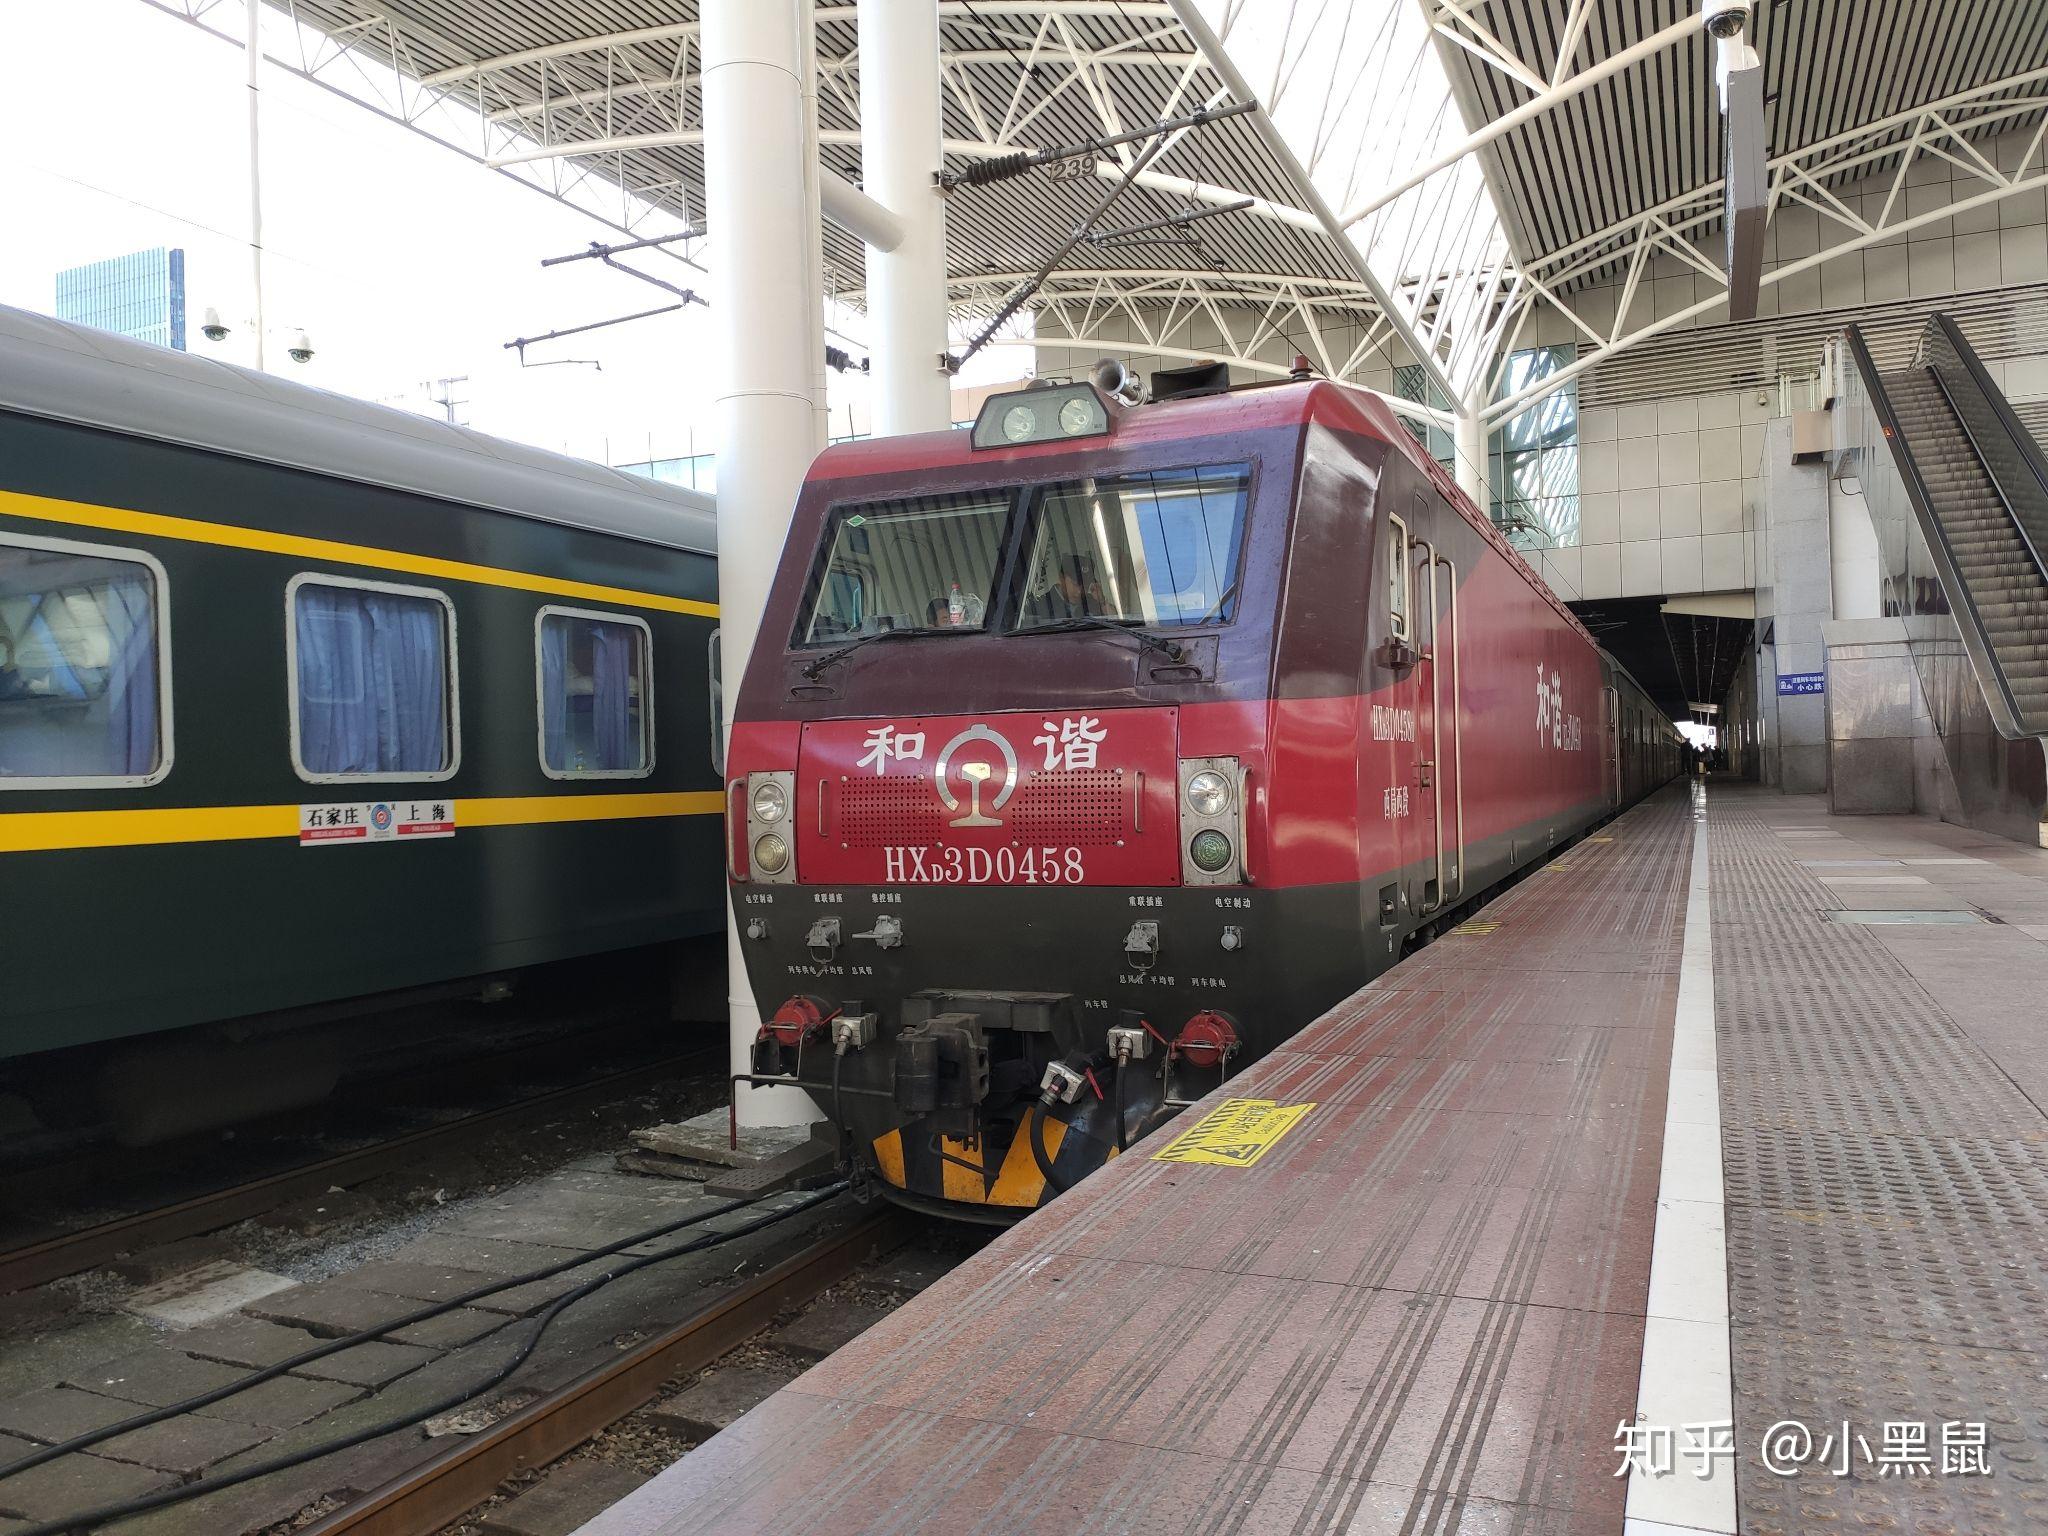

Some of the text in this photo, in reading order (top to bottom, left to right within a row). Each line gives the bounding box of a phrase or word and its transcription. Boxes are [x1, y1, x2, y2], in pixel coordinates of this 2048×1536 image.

[1053, 156, 1096, 180] 239
[857, 715, 1108, 775] 和 谐
[308, 808, 359, 826] 石家庄
[407, 804, 445, 821] 上海
[884, 846, 1084, 883] HXD3D0458
[745, 893, 774, 904] 电空制动
[814, 893, 843, 903] 重联插座
[1128, 896, 1164, 907] 重联插座
[1215, 896, 1251, 908] 电空制动
[788, 965, 817, 975] 列车供电
[1149, 975, 1175, 986] 平均管
[1191, 977, 1227, 988] 列车供电
[1084, 1000, 1108, 1009] 列车管
